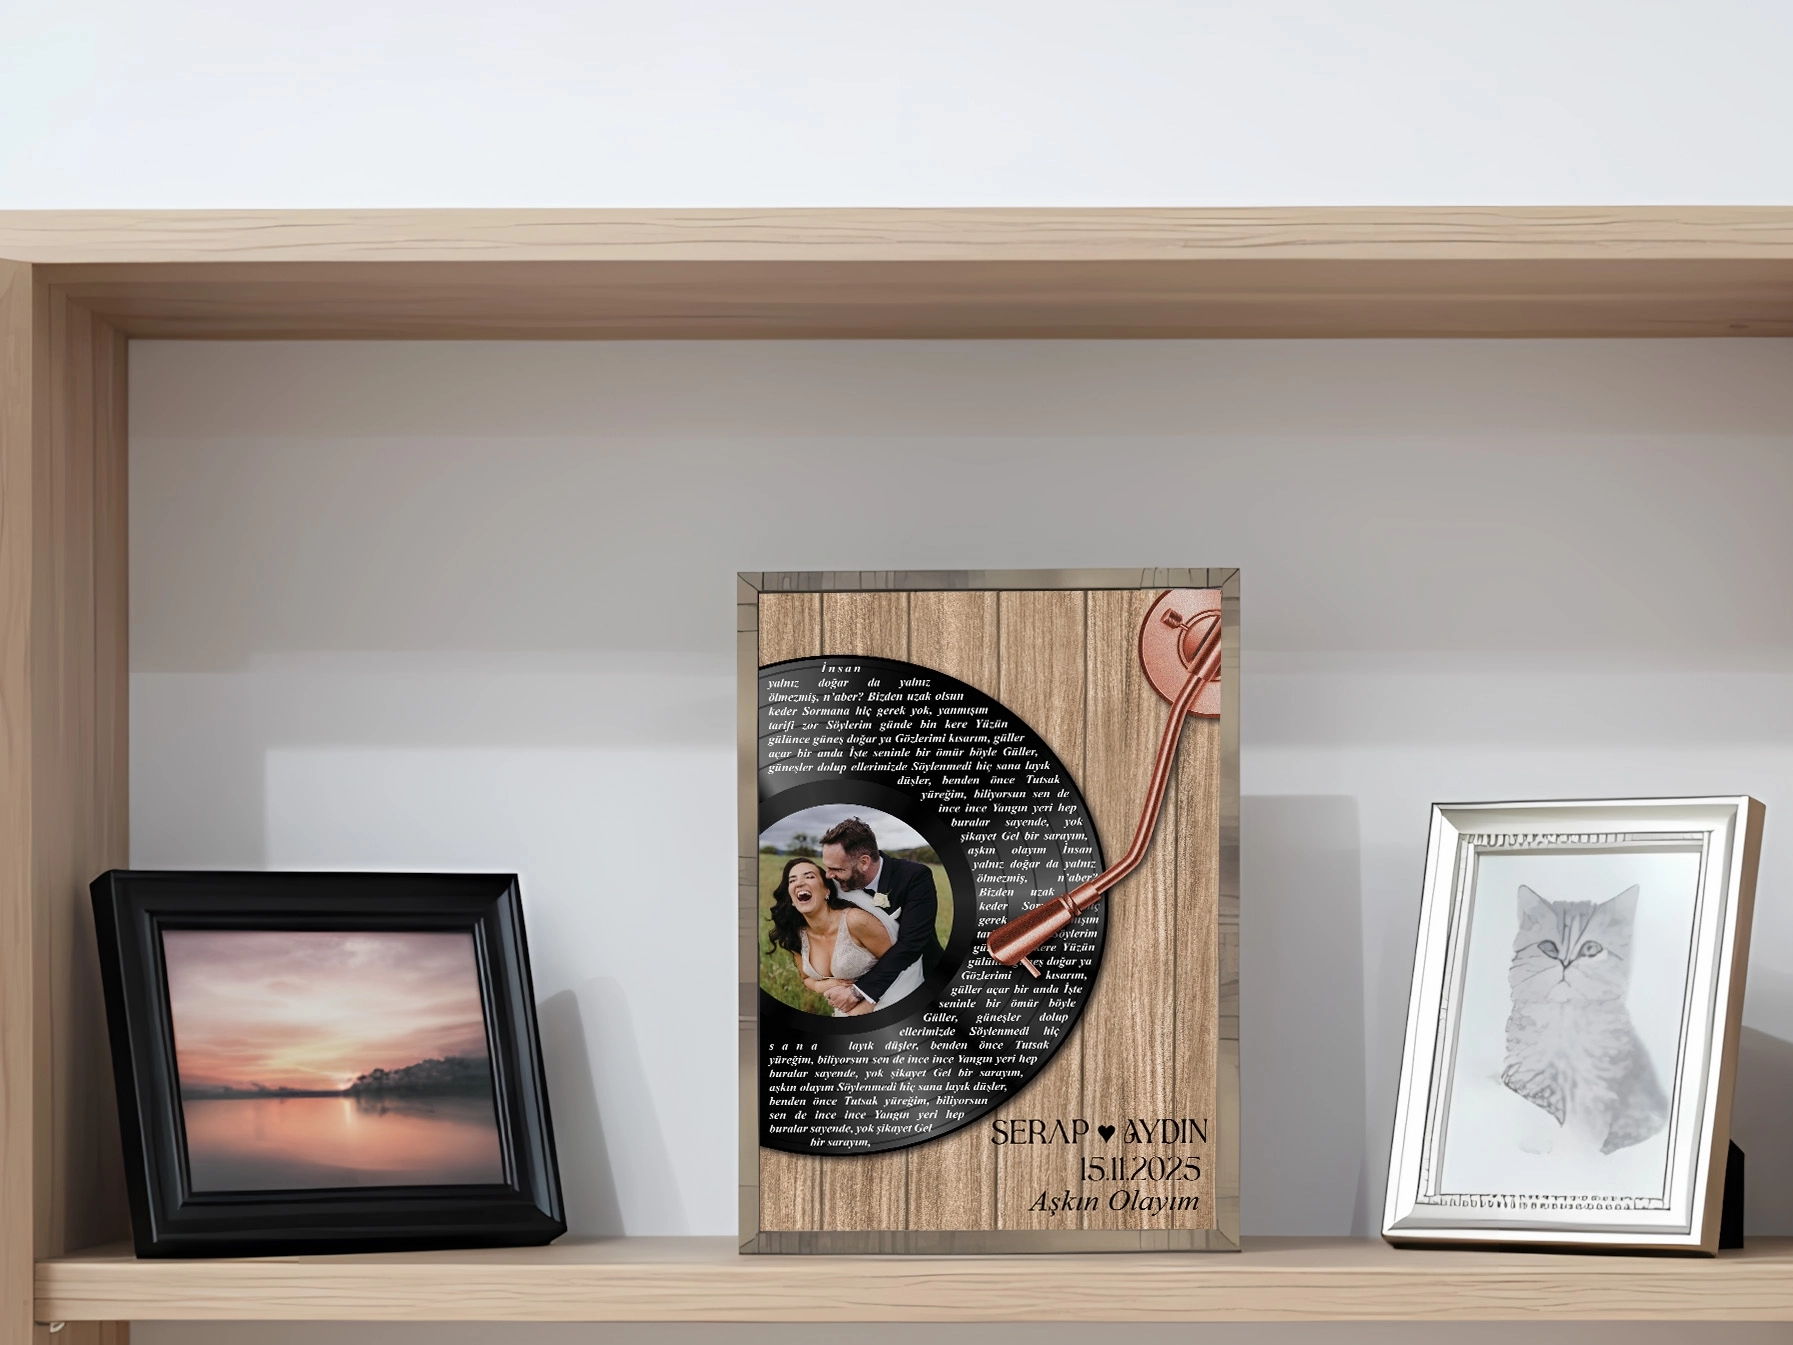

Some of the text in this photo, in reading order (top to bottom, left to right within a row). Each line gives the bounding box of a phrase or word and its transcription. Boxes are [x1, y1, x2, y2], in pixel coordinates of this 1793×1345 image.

[767, 677, 931, 690] yalnız doğar da yalnız
[768, 692, 819, 704] ölmezmiş,
[867, 691, 903, 702] Bizden
[907, 691, 932, 702] uzak
[935, 691, 964, 701] olsun
[768, 705, 989, 718] keder Sormana hiç gerek yok, yanmışım
[768, 719, 1008, 733] tarifi zor Söylerim günde bin kere Yüzün
[767, 733, 1025, 747] gülünce güneş doğar ya Gözlerimi kısarım, güller
[768, 745, 1038, 760] açar bir anda İşte seninle bir ömür böyle Güller,
[767, 762, 814, 775] güneşler
[817, 762, 847, 774] dolup
[850, 761, 908, 772] ellerimizde
[911, 761, 972, 774] Söylenmedi
[975, 761, 993, 773] hiç
[1025, 760, 1051, 773] layık
[897, 774, 1060, 787] düşler, benden önce Tutsak
[920, 789, 967, 802] yüreğim,
[973, 789, 1026, 801] biliyorsun
[1057, 788, 1070, 798] de
[938, 802, 1077, 815] ince ince Yangın yeri hep
[950, 816, 1084, 829] buralar sayende, yok
[960, 831, 1088, 843] şikayet Gel bir sarayım,
[967, 842, 1093, 857] aşkın olayım İnsan
[971, 859, 1096, 871] yalnız doğar da yalnız
[976, 873, 1028, 885] ölmezmiş,
[979, 887, 1055, 897] Bizden uzak
[979, 901, 1008, 911] keder
[1063, 942, 1095, 952] Yüzün
[1046, 956, 1078, 969] doğar
[1078, 959, 1092, 968] ya
[961, 970, 1088, 981] Gözlerimi kısarım,
[950, 982, 1083, 997] güller açar bir anda İşte
[938, 998, 1077, 1010] seninle bir ömür böyle
[923, 1012, 1069, 1024] Güller, güneşler dolup
[899, 1026, 1060, 1038] ellerimizde Söylenmedi hiç
[848, 1041, 874, 1053] layık
[884, 1041, 919, 1052] düşler,
[930, 1040, 968, 1050] benden
[978, 1040, 1004, 1050] önce
[1015, 1040, 1050, 1050] Tutsak
[767, 1055, 814, 1067] yüreğim,
[817, 1055, 869, 1067] biliyorsun
[892, 1055, 905, 1064] de
[907, 1054, 930, 1064] ince
[932, 1054, 955, 1064] ince
[958, 1054, 993, 1066] Yangın
[994, 1054, 1017, 1066] yeri
[1018, 1054, 1038, 1066] hep
[769, 1067, 1024, 1081] buralar sayende, yok şikayet Gel bir sarayım,
[769, 1082, 797, 1094] aşkın
[799, 1082, 835, 1094] olayım
[836, 1082, 897, 1094] Söylenmedi
[899, 1082, 916, 1093] hiç
[945, 1081, 971, 1094] layık
[973, 1081, 1007, 1093] düşler,
[769, 1095, 988, 1108] benden önce Tutsak yüreğim, biliyorsun
[768, 1109, 964, 1121] sen de ince ince Yangın yeri hep
[769, 1123, 933, 1136] buralar sayende, yok şikayet Gel
[991, 1118, 1208, 1145] SERAP AYDIN
[810, 1137, 871, 1150] bir sarayım,
[1081, 1156, 1200, 1181] 15.11.2025
[1028, 1190, 1199, 1217] Aşkın Olayım
